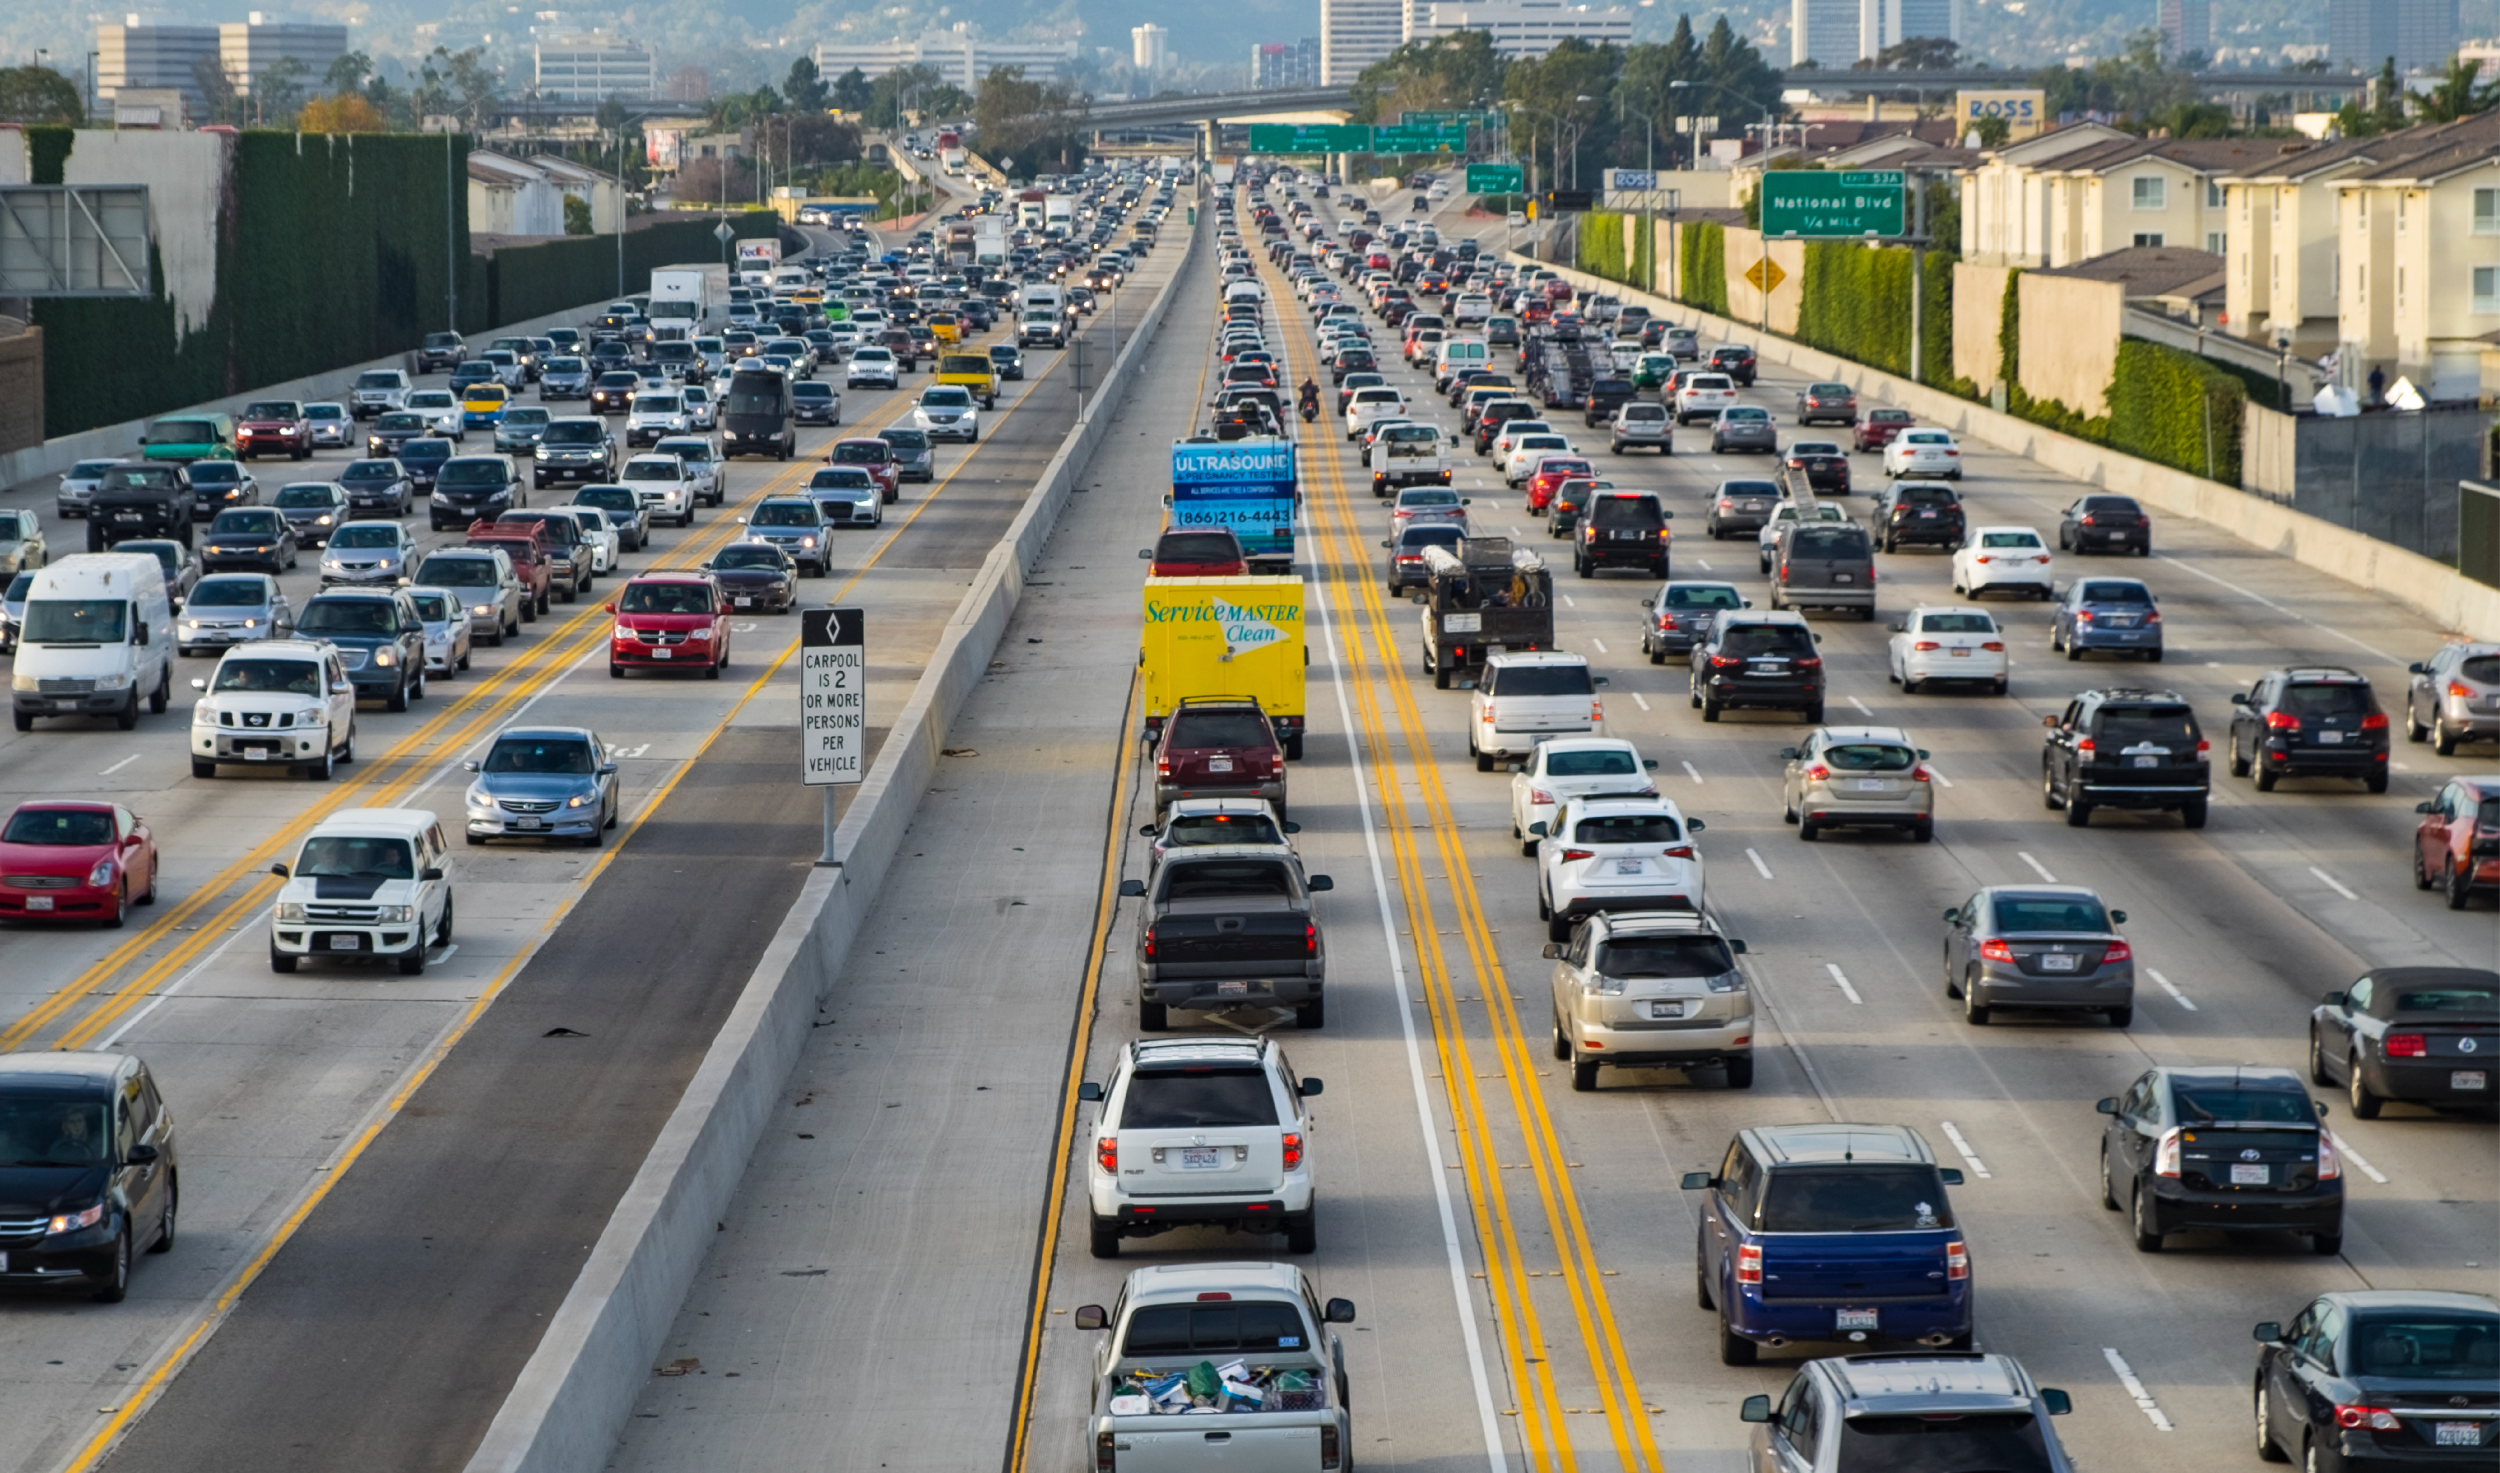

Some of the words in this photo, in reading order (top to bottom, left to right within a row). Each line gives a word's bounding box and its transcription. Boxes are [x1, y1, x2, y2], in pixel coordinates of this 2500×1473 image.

[1970, 100, 2033, 118] ROSS
[1616, 173, 1655, 188] ROSS
[1873, 174, 1898, 183] 53A
[1774, 196, 1846, 208] National
[1855, 196, 1892, 208] Blvd
[1829, 217, 1861, 227] MILE
[740, 246, 771, 257] FedEx
[1176, 454, 1288, 471] ULTRASOUND
[1186, 472, 1245, 480] PREGNANCY
[1249, 471, 1288, 479] TESTING
[1178, 511, 1290, 525] (866)216-4443
[1226, 624, 1275, 643] Clean
[806, 653, 860, 669] CARPOOL
[819, 673, 830, 688] IS
[835, 670, 846, 689] 2
[806, 695, 823, 708] OR
[827, 693, 860, 708] MORE
[1154, 696, 1159, 704] 7
[806, 714, 860, 730] PERSONS
[823, 736, 844, 750] PER
[810, 756, 857, 772] VEHICLE
